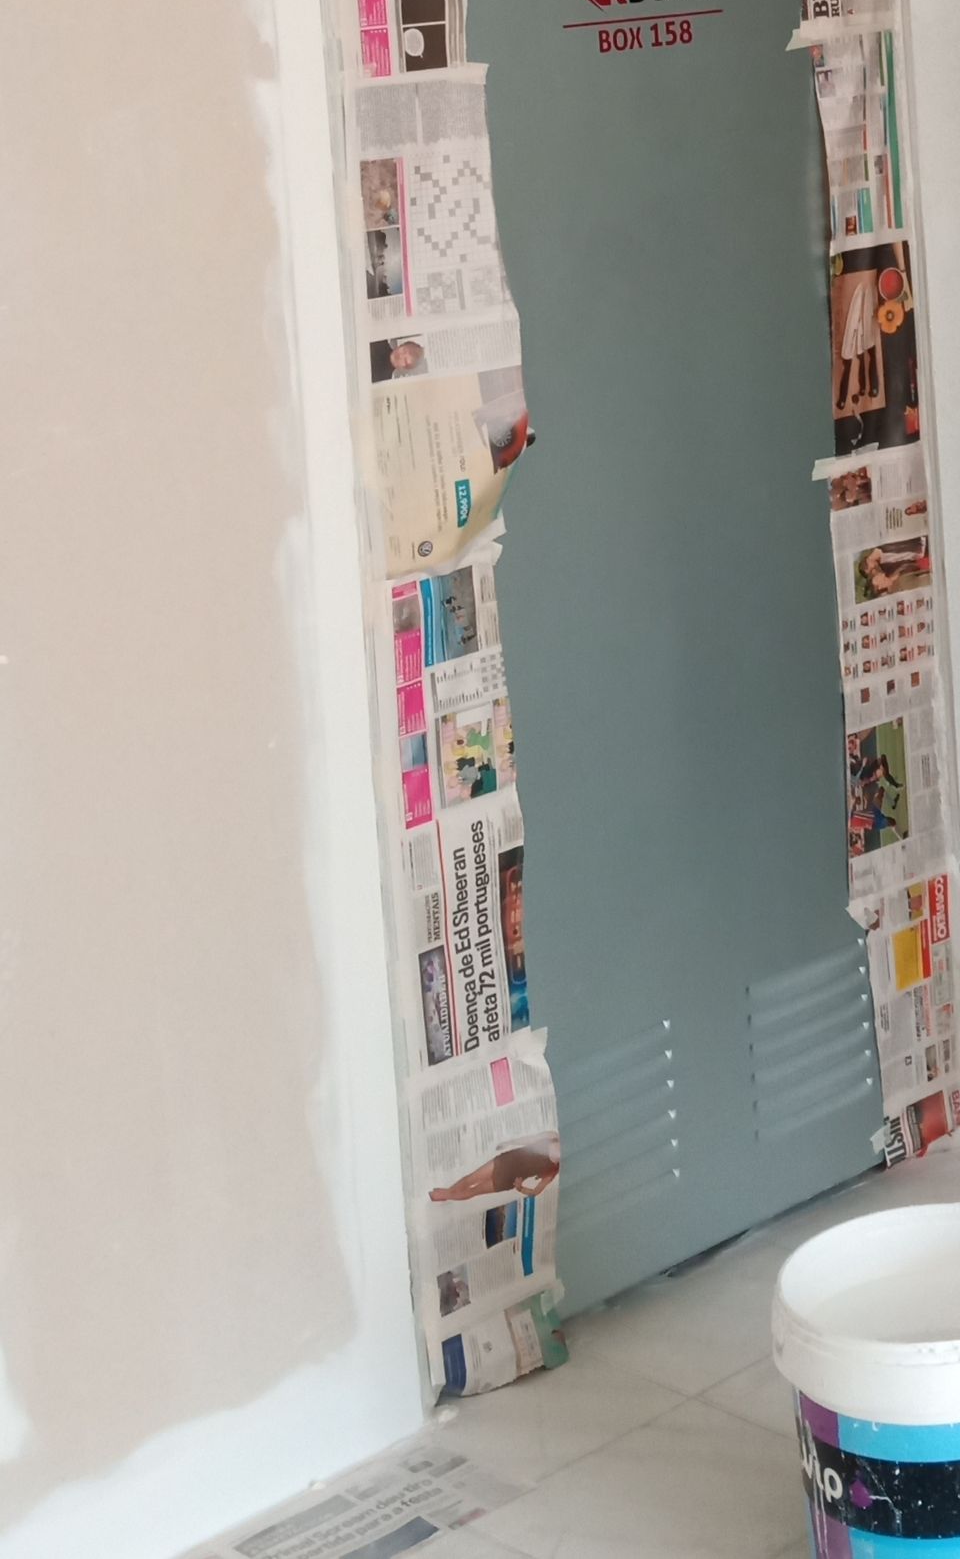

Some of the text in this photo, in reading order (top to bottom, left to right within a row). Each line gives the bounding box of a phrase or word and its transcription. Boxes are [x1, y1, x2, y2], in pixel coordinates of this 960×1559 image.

[598, 20, 693, 53] BOX 158
[431, 891, 442, 942] MENTAIS
[452, 847, 481, 1053] Doença de Ed Sheeran
[471, 819, 500, 1043] afeta 72 mil portugueses
